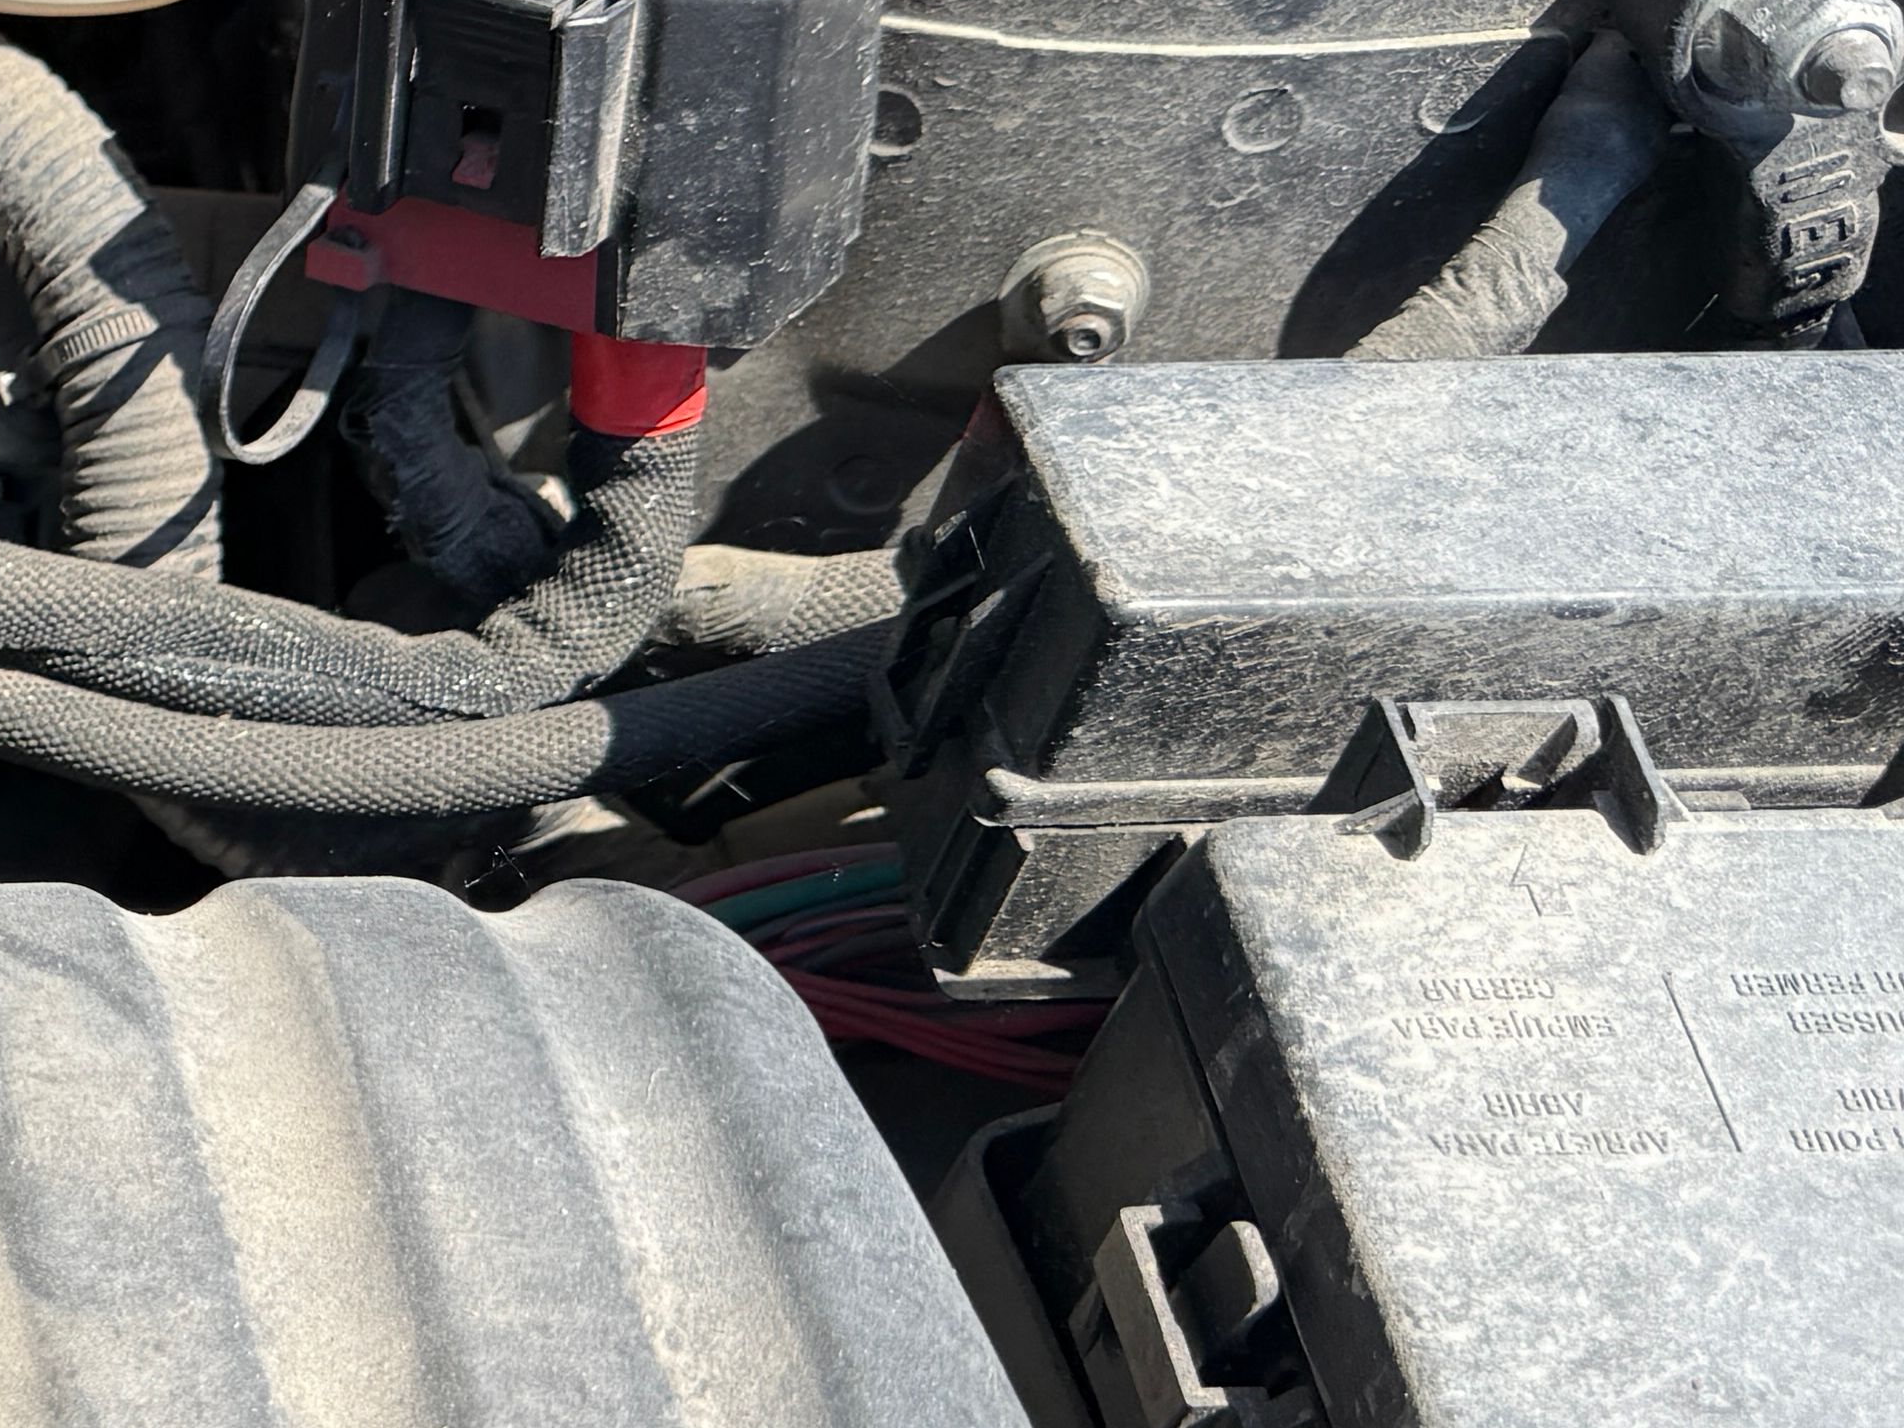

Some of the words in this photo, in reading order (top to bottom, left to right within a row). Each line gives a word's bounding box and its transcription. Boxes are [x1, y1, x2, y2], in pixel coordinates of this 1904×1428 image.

[1419, 976, 1555, 1002] CERRAR
[1730, 973, 1868, 997] FERMER
[1392, 1014, 1484, 1039] PARA
[1495, 1010, 1617, 1039] EMPUJE
[1786, 1011, 1904, 1034] USSER
[1482, 1089, 1586, 1118] ABRIR
[1531, 1128, 1670, 1156] APRIETE
[1788, 1128, 1887, 1153] POUR
